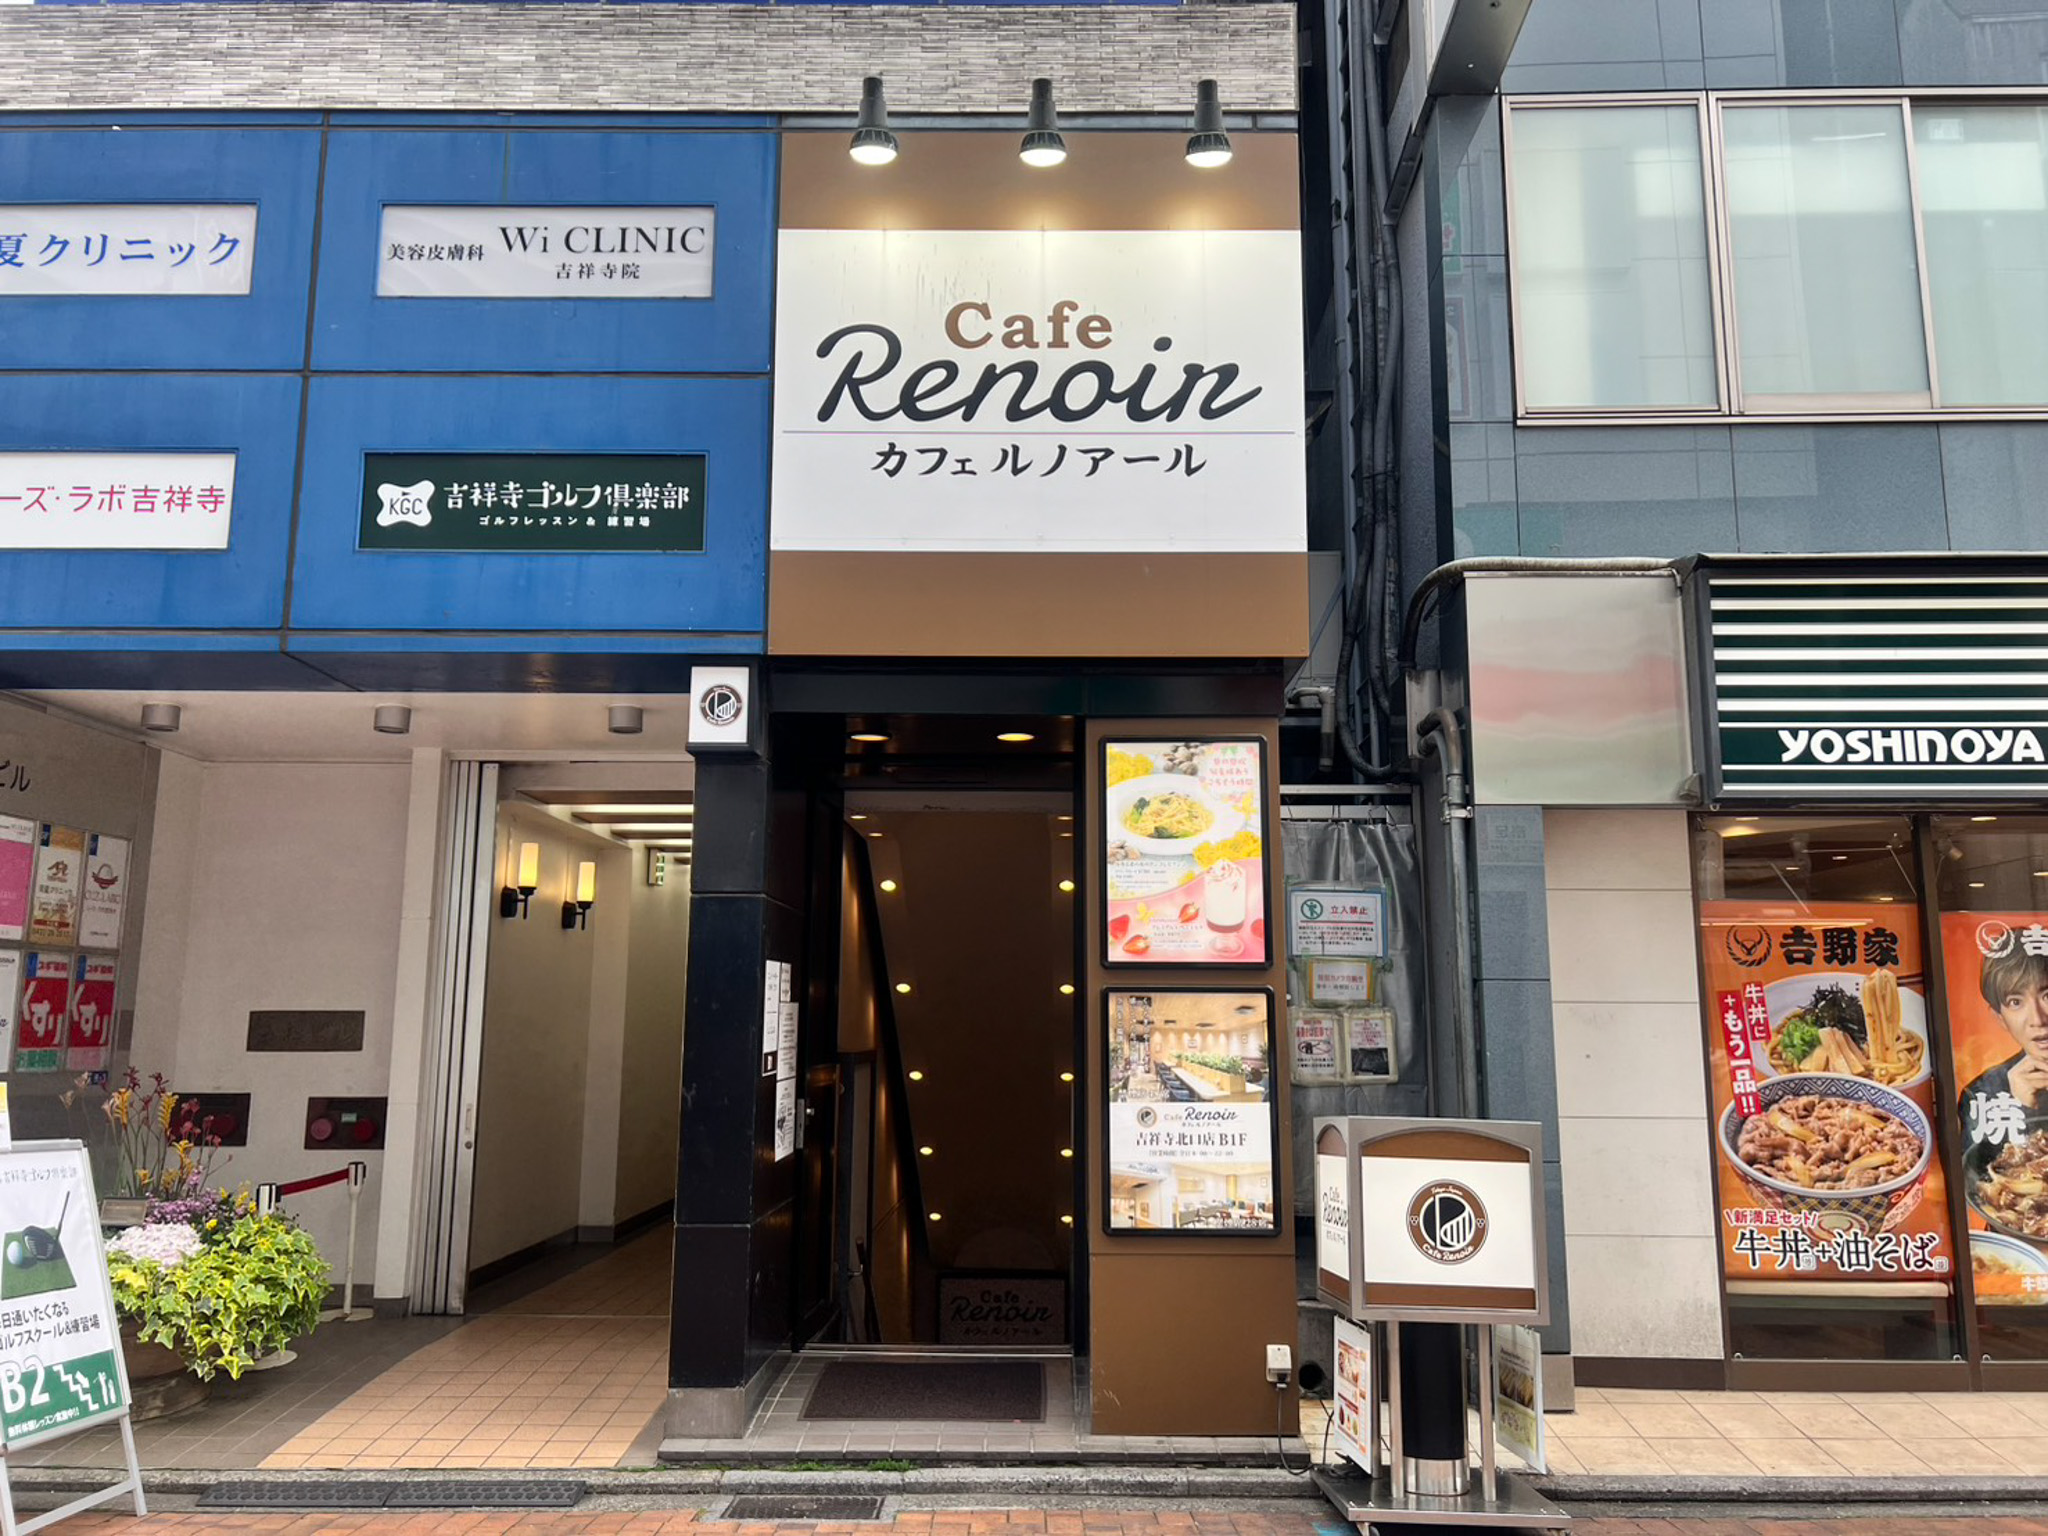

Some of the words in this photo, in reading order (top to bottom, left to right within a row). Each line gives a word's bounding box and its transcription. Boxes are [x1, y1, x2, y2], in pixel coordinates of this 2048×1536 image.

[387, 243, 484, 261] 美容皮膚科
[498, 226, 548, 253] Wi
[564, 226, 705, 254] CLINIC
[555, 262, 640, 279] 吉祥寺院
[944, 300, 1112, 349] Cafe
[816, 323, 1262, 422] Renoir
[871, 442, 1207, 477] カフェルノアール
[389, 496, 423, 516] KGC
[443, 481, 689, 509] 吉祥寺ゴルフ倶楽部
[479, 516, 578, 526] ゴルフレッスン
[607, 516, 650, 527] 練習場
[1778, 729, 2046, 762] YOSHINOYA
[1330, 906, 1368, 915] 立入禁止
[23, 980, 63, 1045] くすり
[72, 983, 109, 1045] くすり
[1744, 983, 1767, 1038] 牛丼に
[1184, 1107, 1238, 1121] Renoir
[1969, 1092, 2026, 1144] 焼
[1733, 1210, 1811, 1226] 新満足セット
[1422, 1243, 1442, 1260] Cafe
[0, 1301, 69, 1329] 日通いたくなる
[950, 1296, 1053, 1322] Renoir
[0, 1354, 51, 1414] B2
